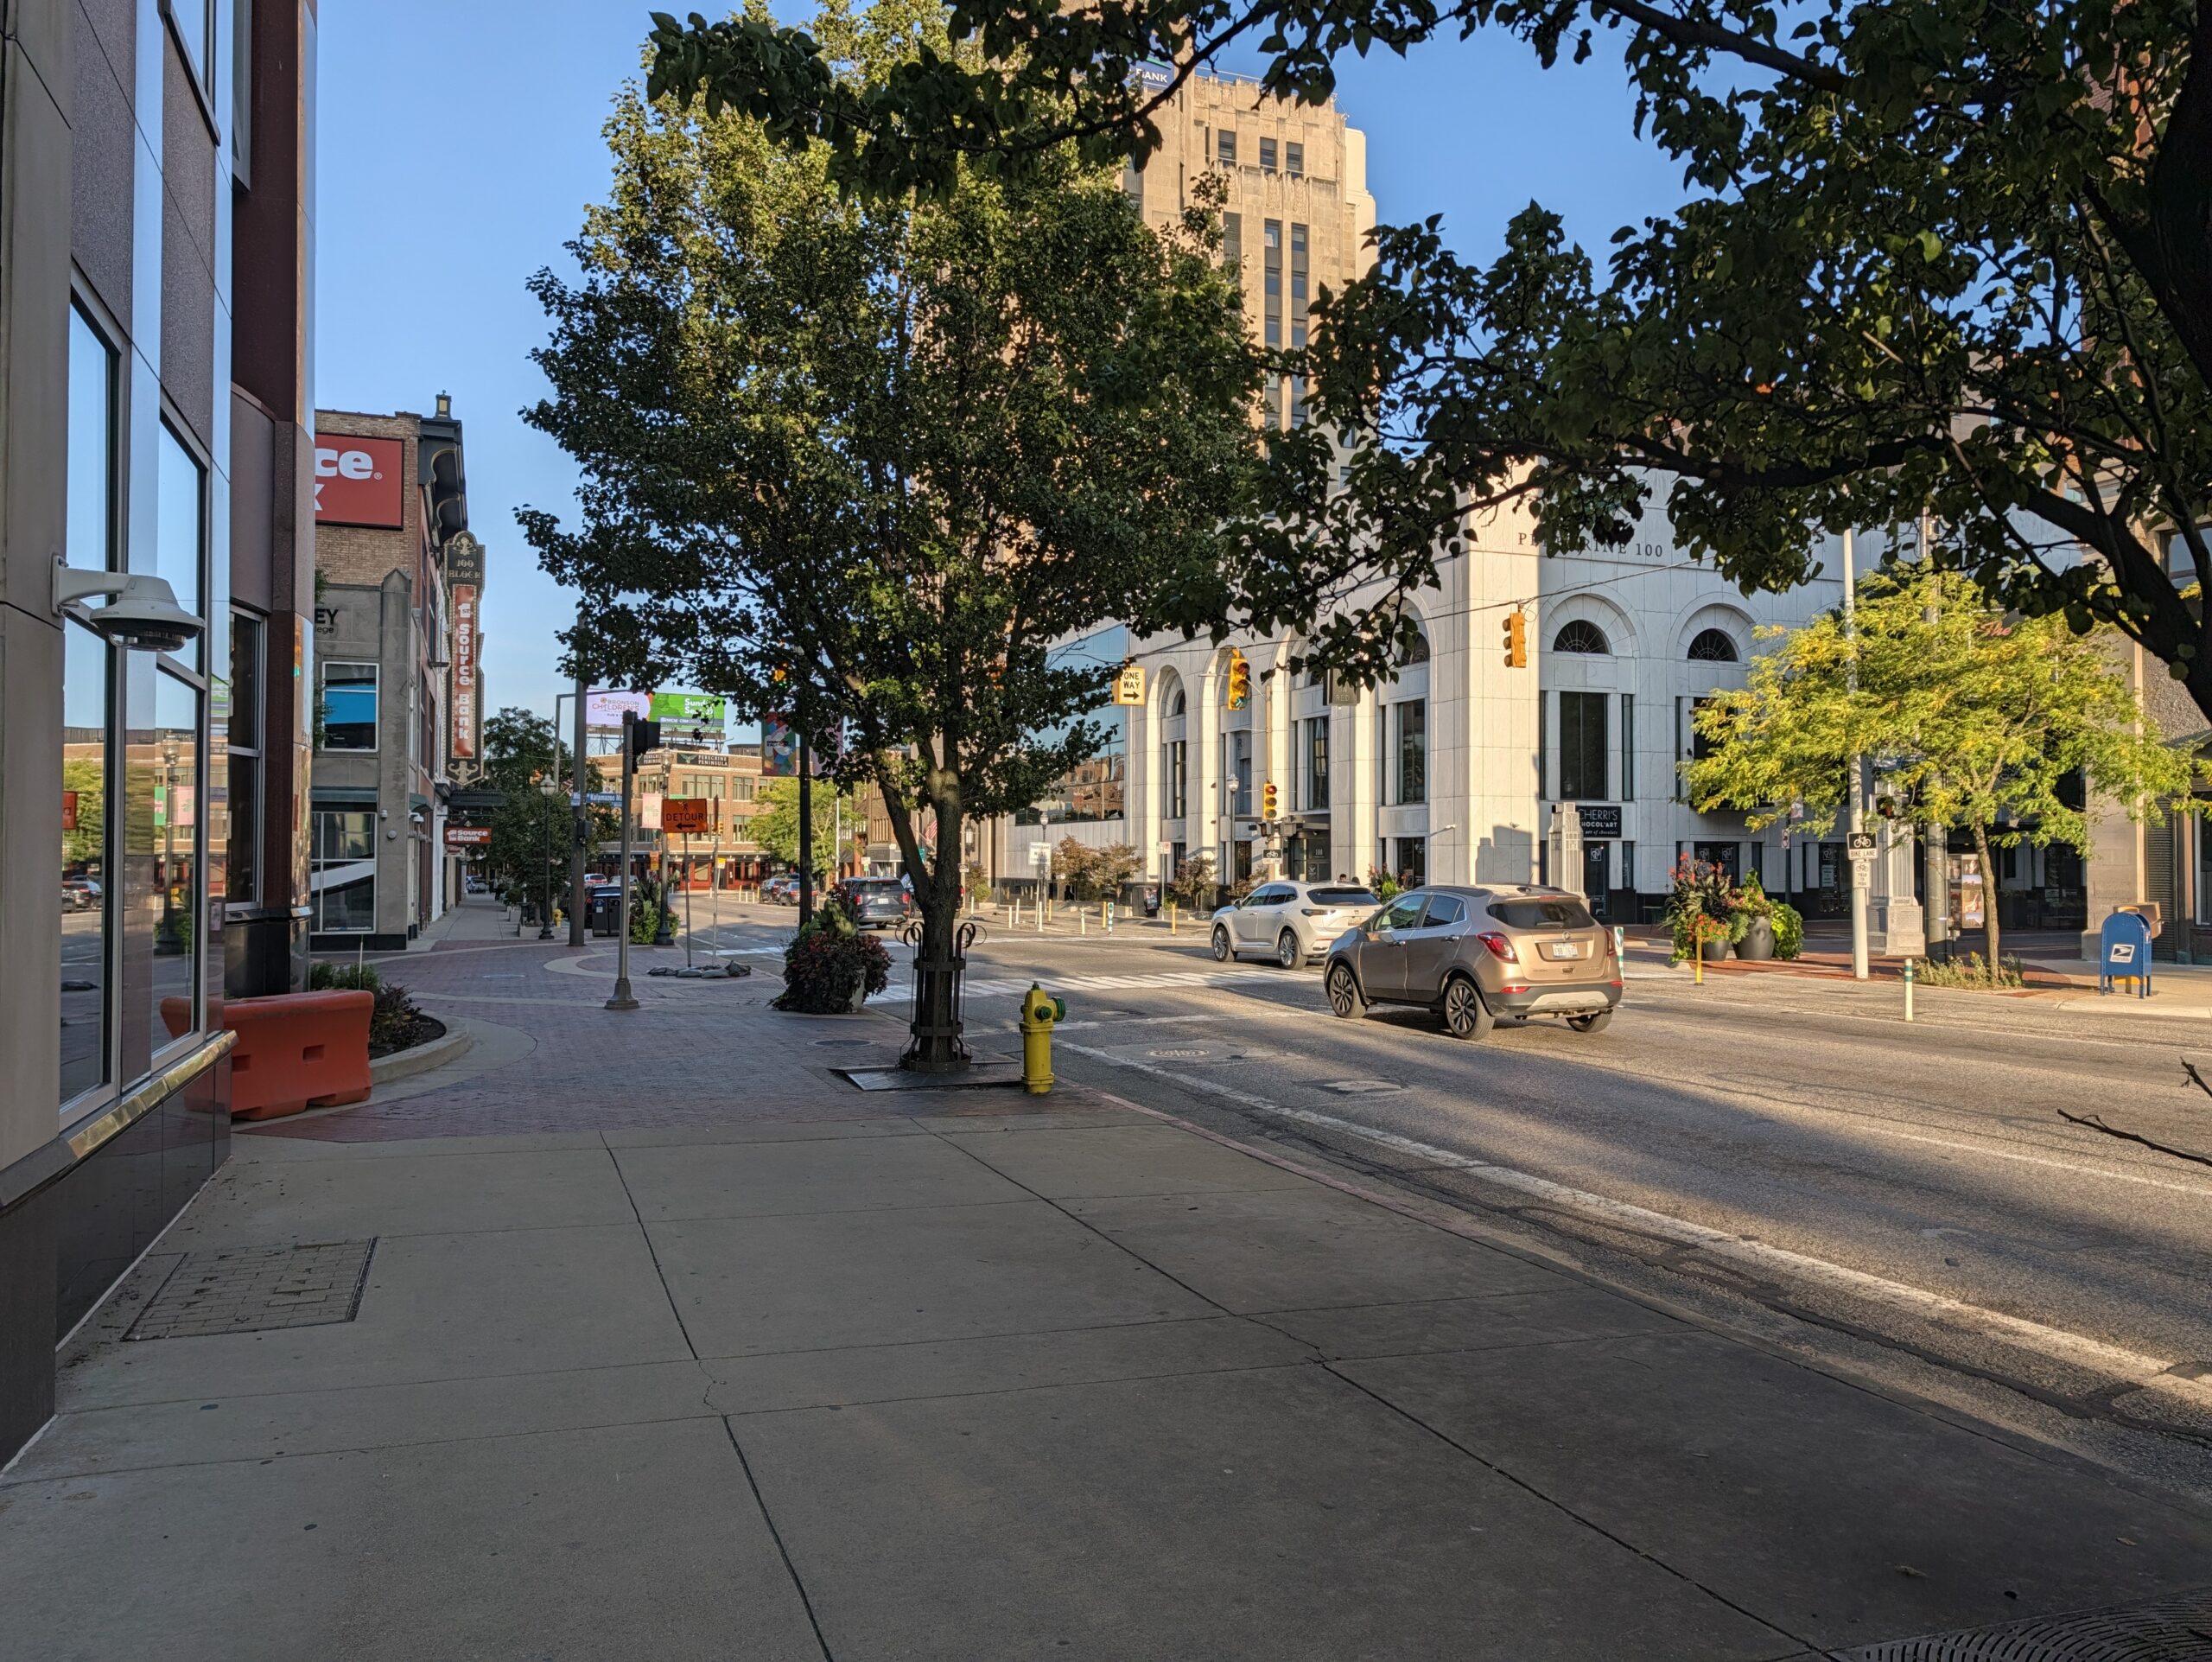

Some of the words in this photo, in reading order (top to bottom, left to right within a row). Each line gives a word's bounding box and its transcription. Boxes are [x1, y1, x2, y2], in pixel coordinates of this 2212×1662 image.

[1636, 543, 1662, 557] 100
[456, 559, 474, 568] 100
[448, 570, 481, 579] BLOCK
[458, 622, 470, 686] Source
[1123, 672, 1140, 680] ONE
[458, 693, 469, 740] Bank
[665, 812, 704, 822] DETOUR
[1578, 808, 1618, 821] CHERRI'S
